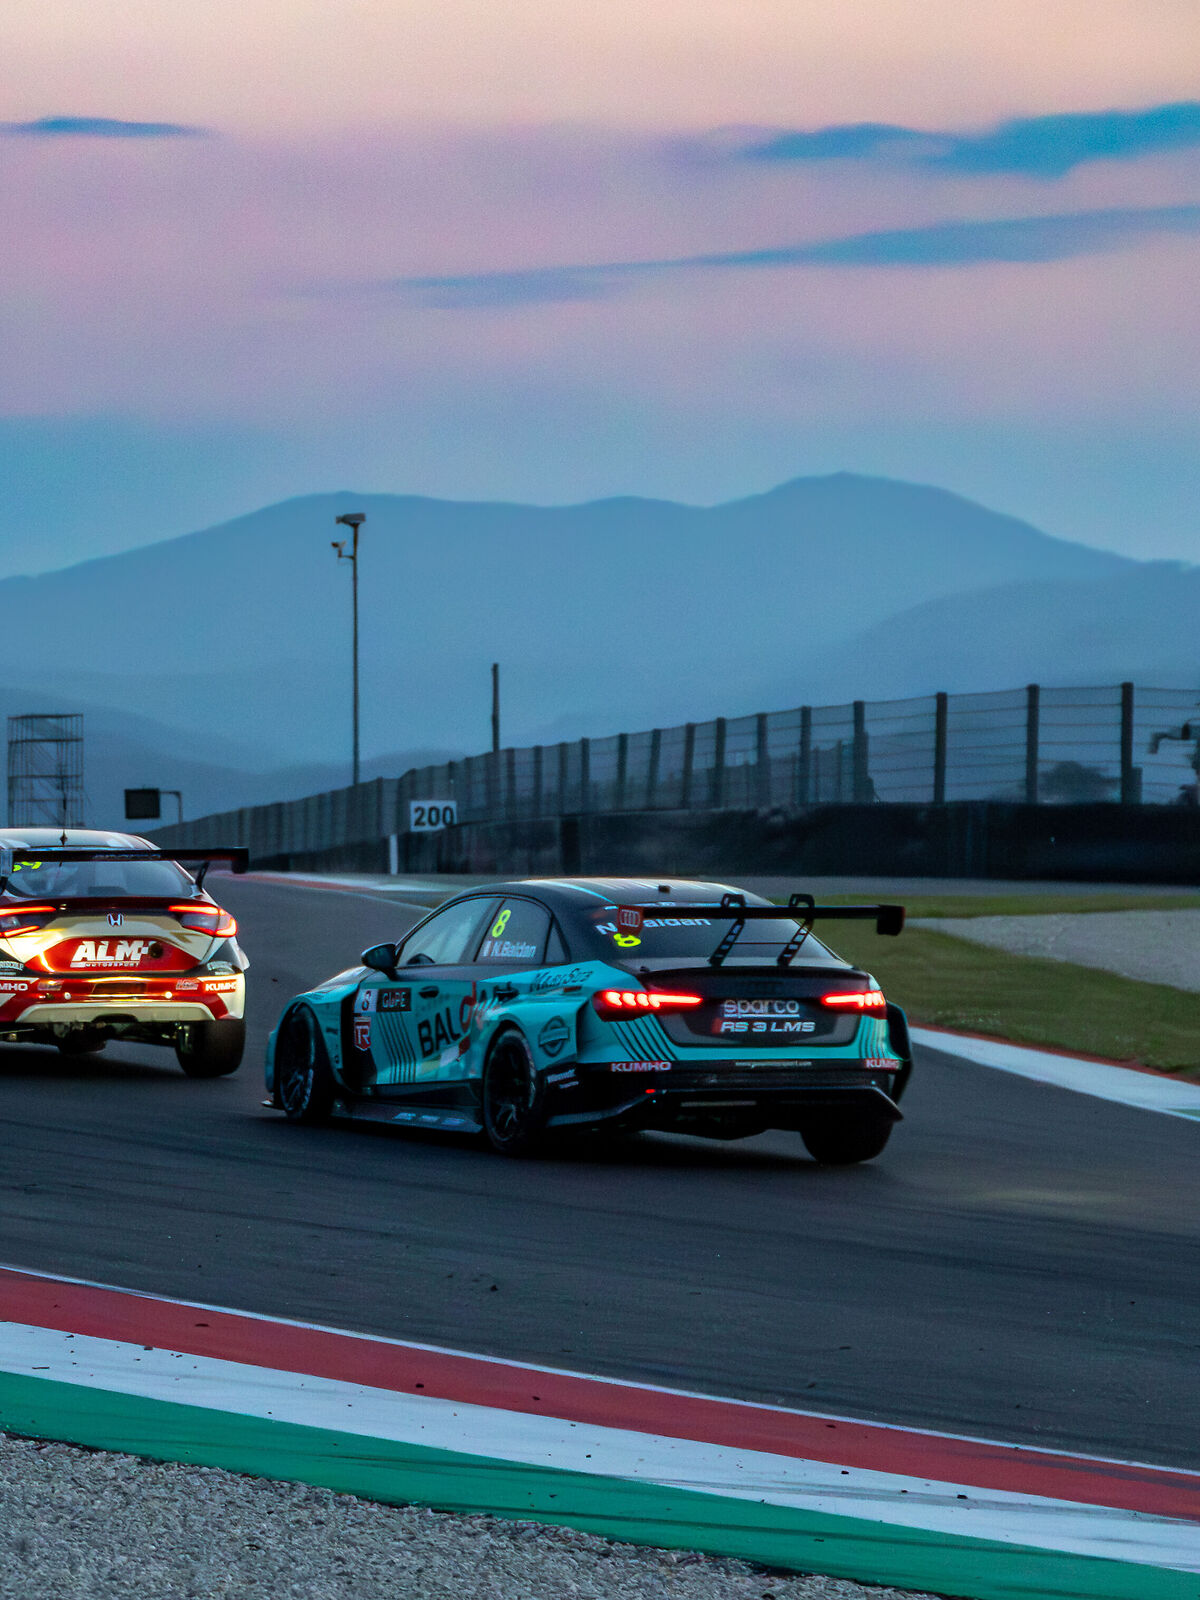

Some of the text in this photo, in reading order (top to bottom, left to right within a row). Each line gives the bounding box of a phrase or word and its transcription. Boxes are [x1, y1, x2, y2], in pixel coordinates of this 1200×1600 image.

[414, 806, 455, 827] 200
[492, 909, 512, 938] 8
[70, 940, 144, 961] ALM
[724, 1000, 800, 1019] sparco
[720, 1021, 816, 1033] RS 3 LMS
[611, 1061, 672, 1073] KUMHO
